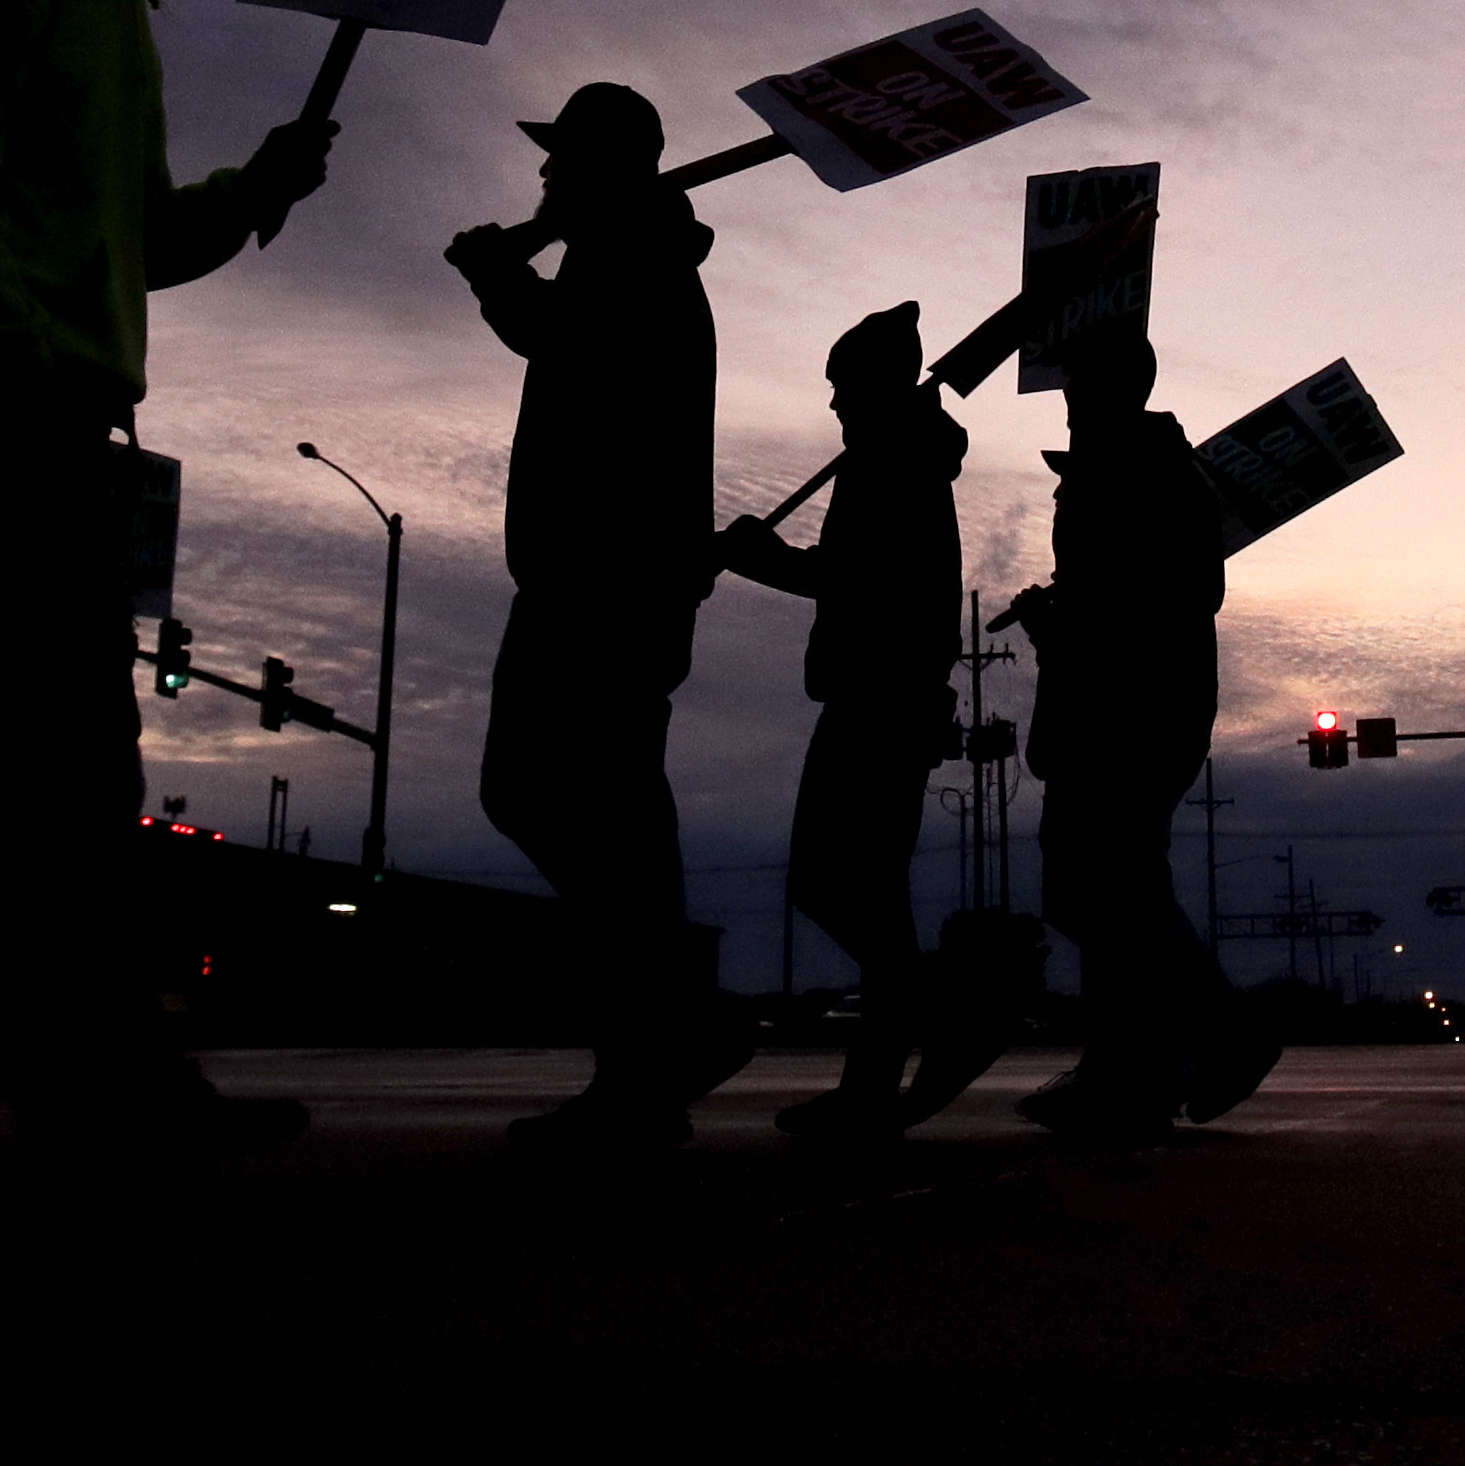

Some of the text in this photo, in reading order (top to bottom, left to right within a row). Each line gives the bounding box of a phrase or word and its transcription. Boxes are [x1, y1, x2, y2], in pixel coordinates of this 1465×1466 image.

[876, 71, 966, 110] ON
[934, 21, 1066, 109] UAW
[775, 70, 963, 156] STRIKE
[1257, 425, 1319, 468] ON
[1307, 372, 1389, 464] UAW
[1198, 434, 1313, 517] STRIKE
